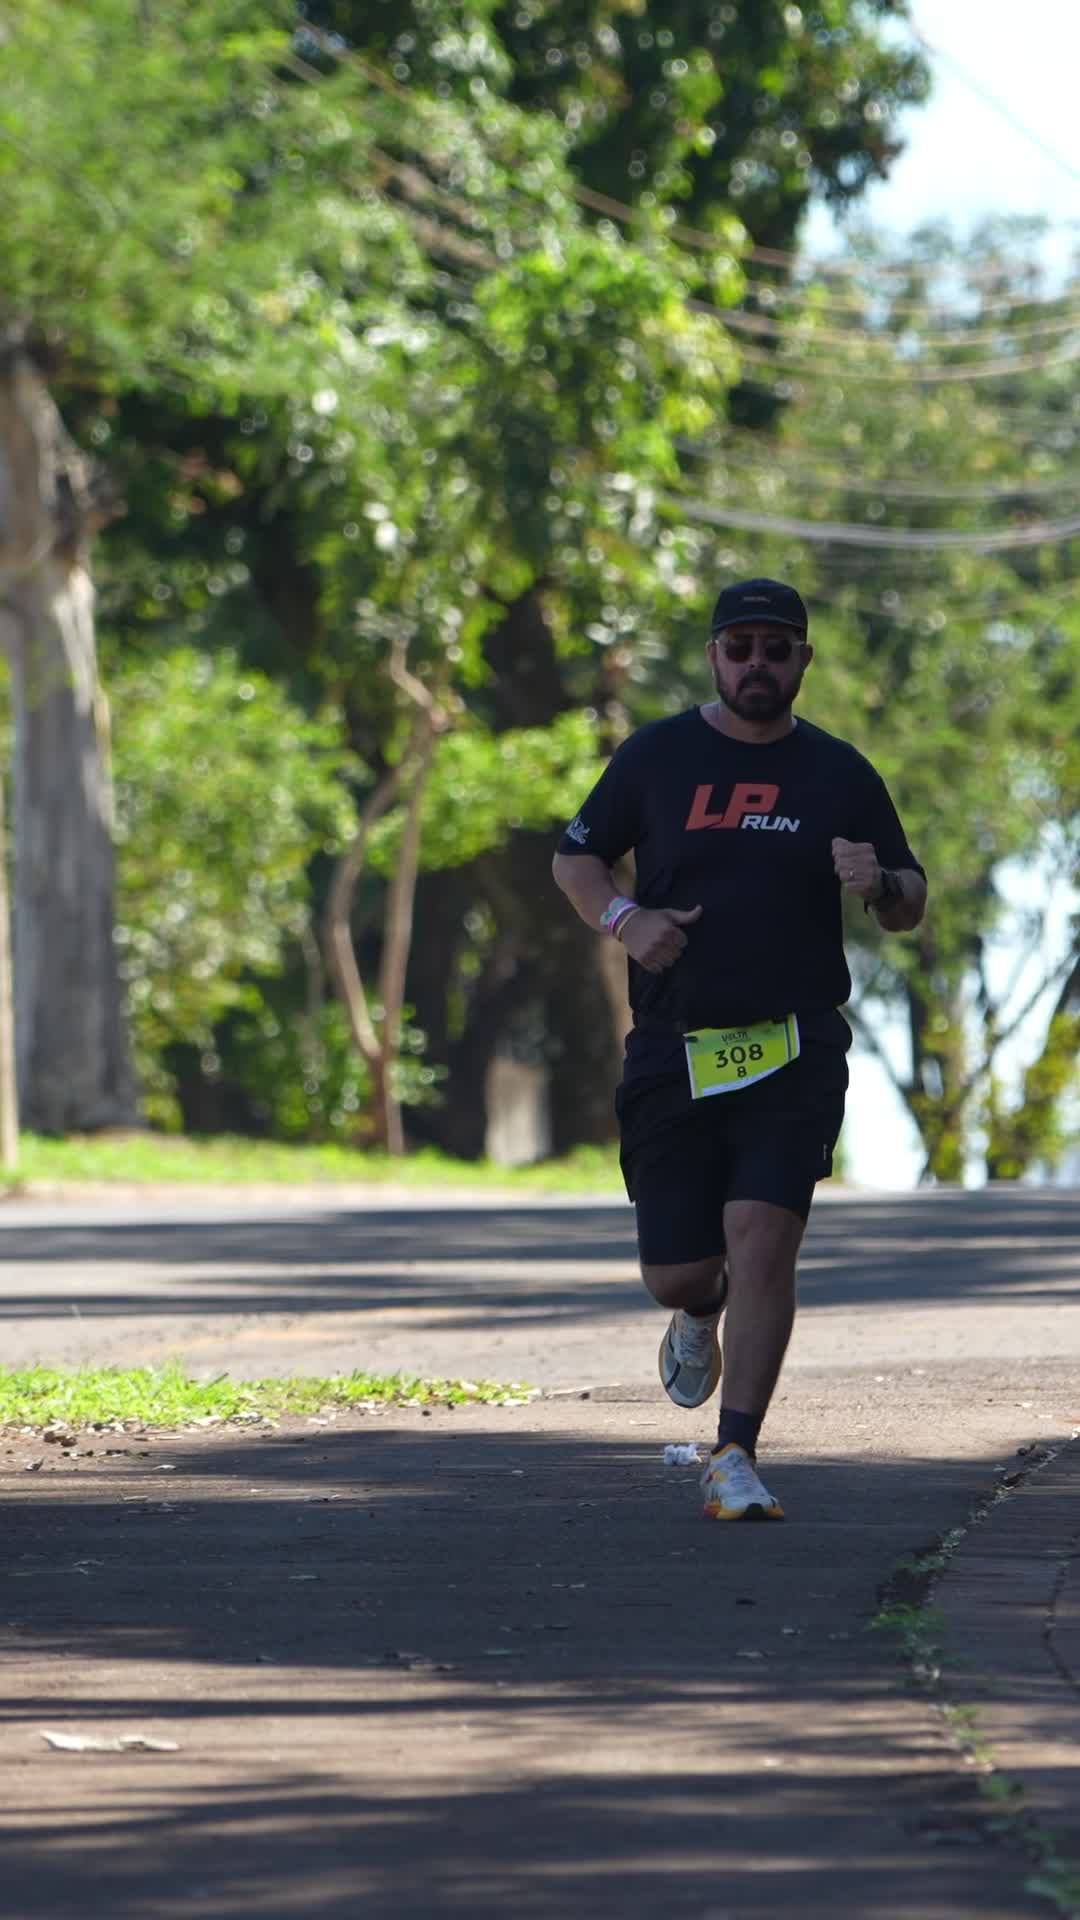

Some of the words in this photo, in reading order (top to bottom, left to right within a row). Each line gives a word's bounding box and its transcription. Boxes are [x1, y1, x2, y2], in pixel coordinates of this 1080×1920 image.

[685, 783, 779, 830] LP
[741, 815, 800, 832] RUN
[714, 1043, 764, 1069] 308
